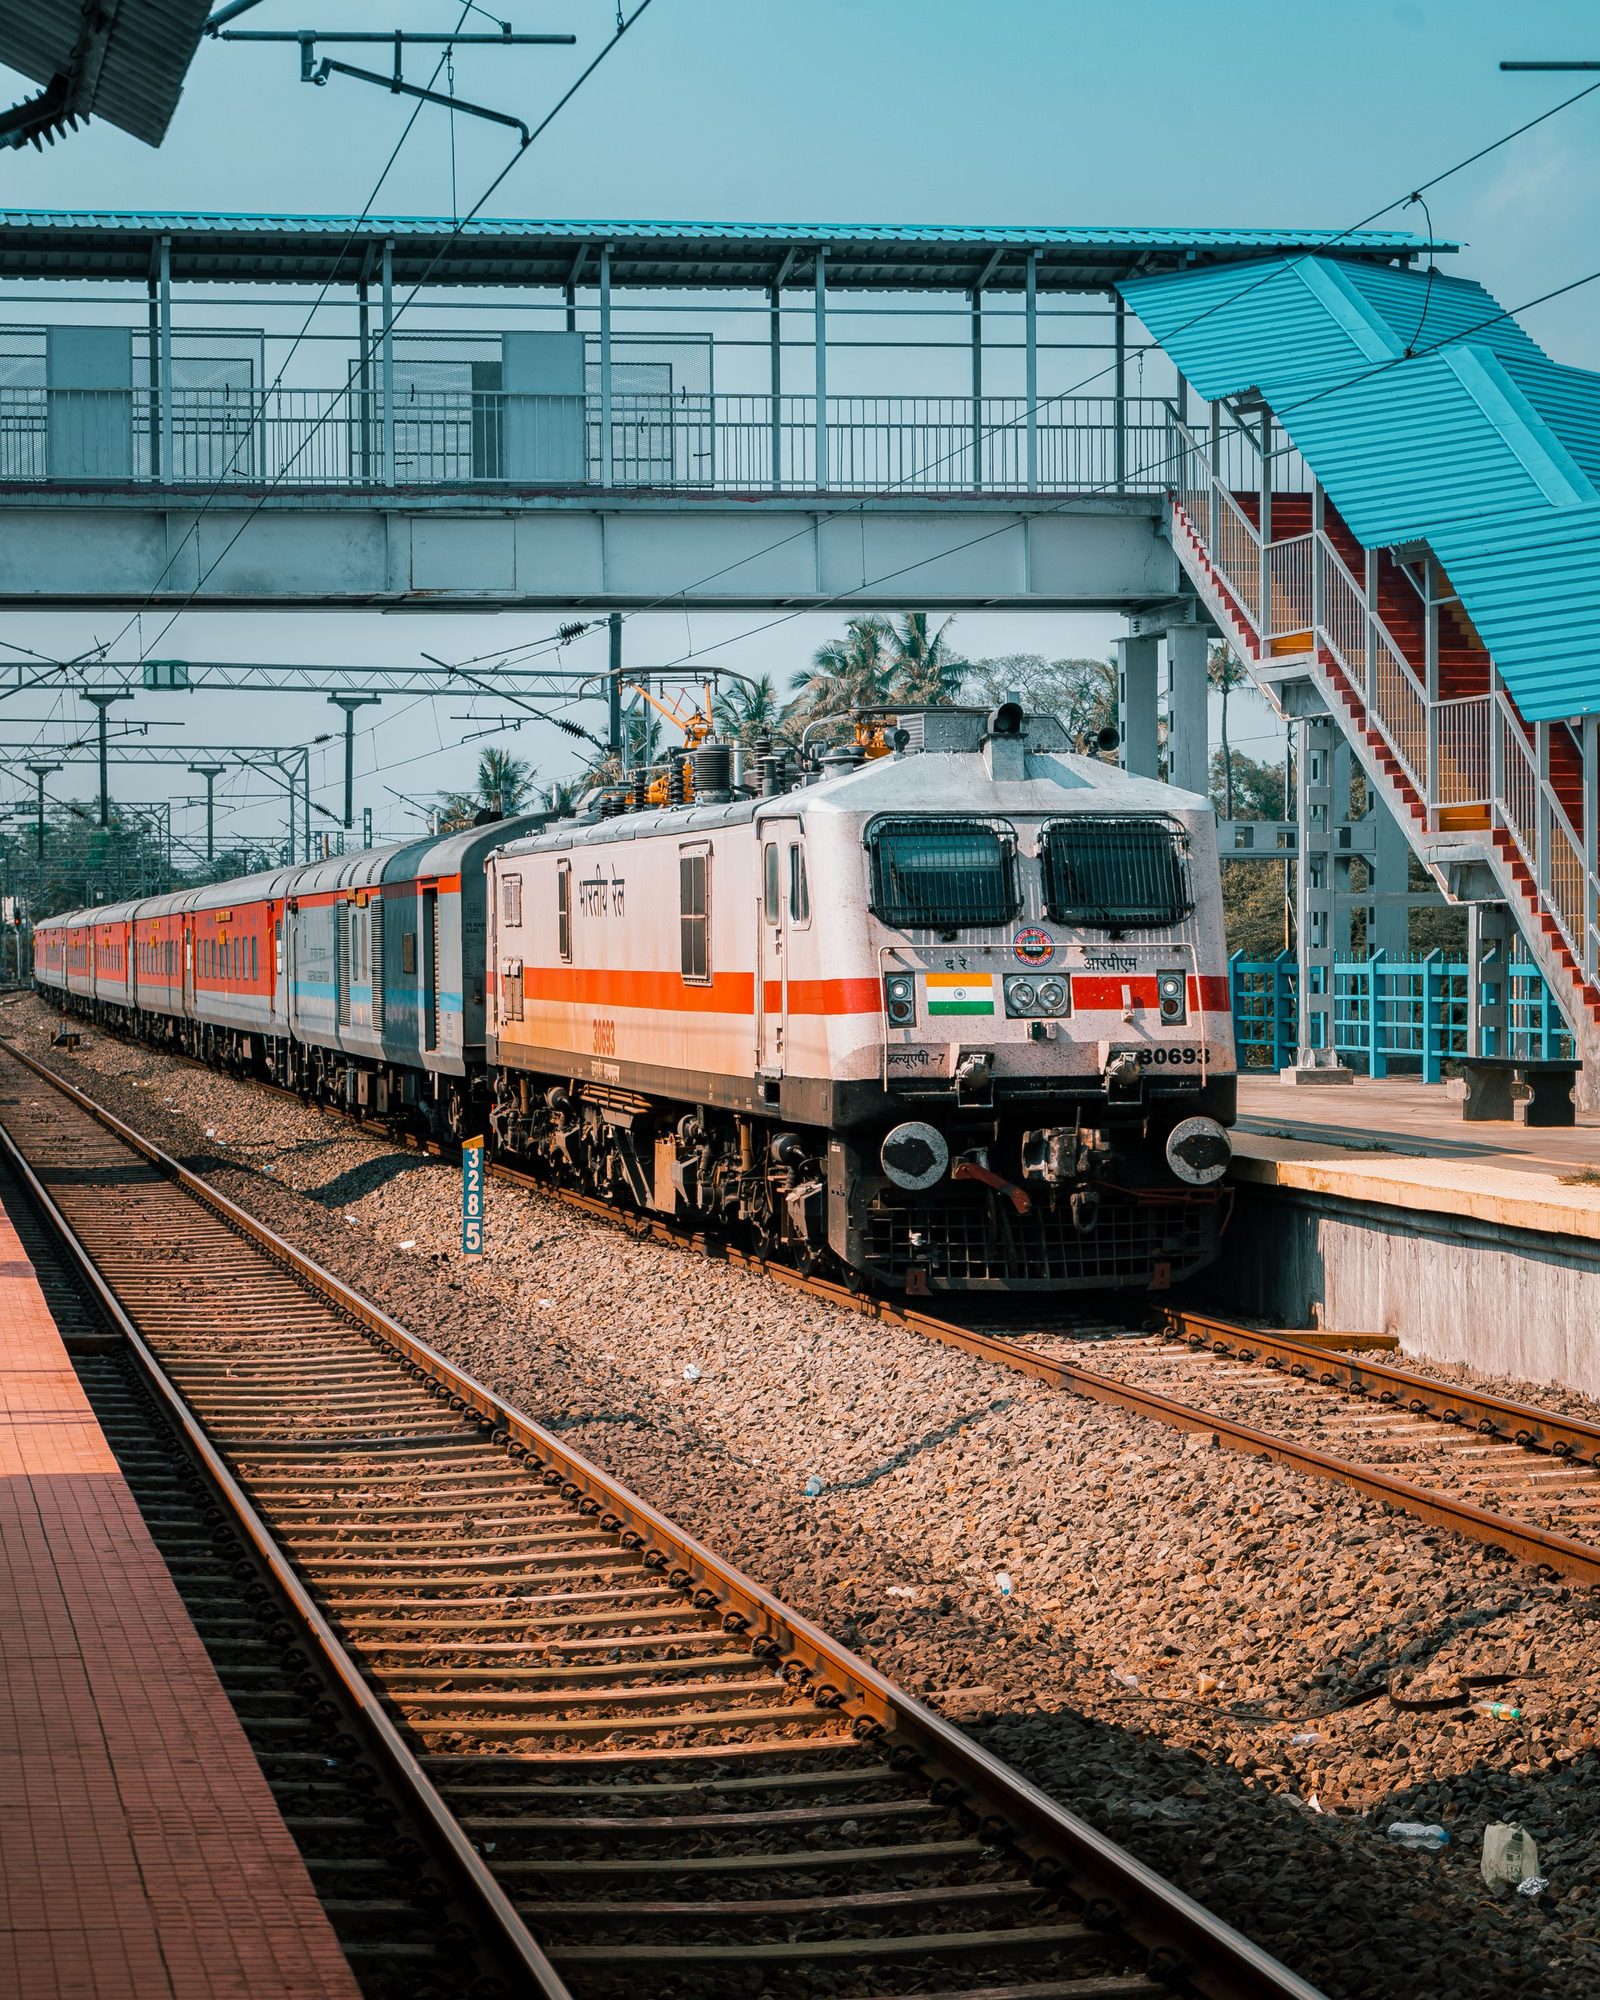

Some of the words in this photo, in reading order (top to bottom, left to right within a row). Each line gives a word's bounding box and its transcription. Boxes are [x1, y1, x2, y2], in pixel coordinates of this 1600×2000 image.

[579, 864, 608, 917] भारतीय
[612, 862, 625, 917] रेल
[1020, 953, 1050, 965] ROYAPURAM
[1083, 952, 1137, 973] आरपीएम
[592, 1018, 616, 1056] 30693
